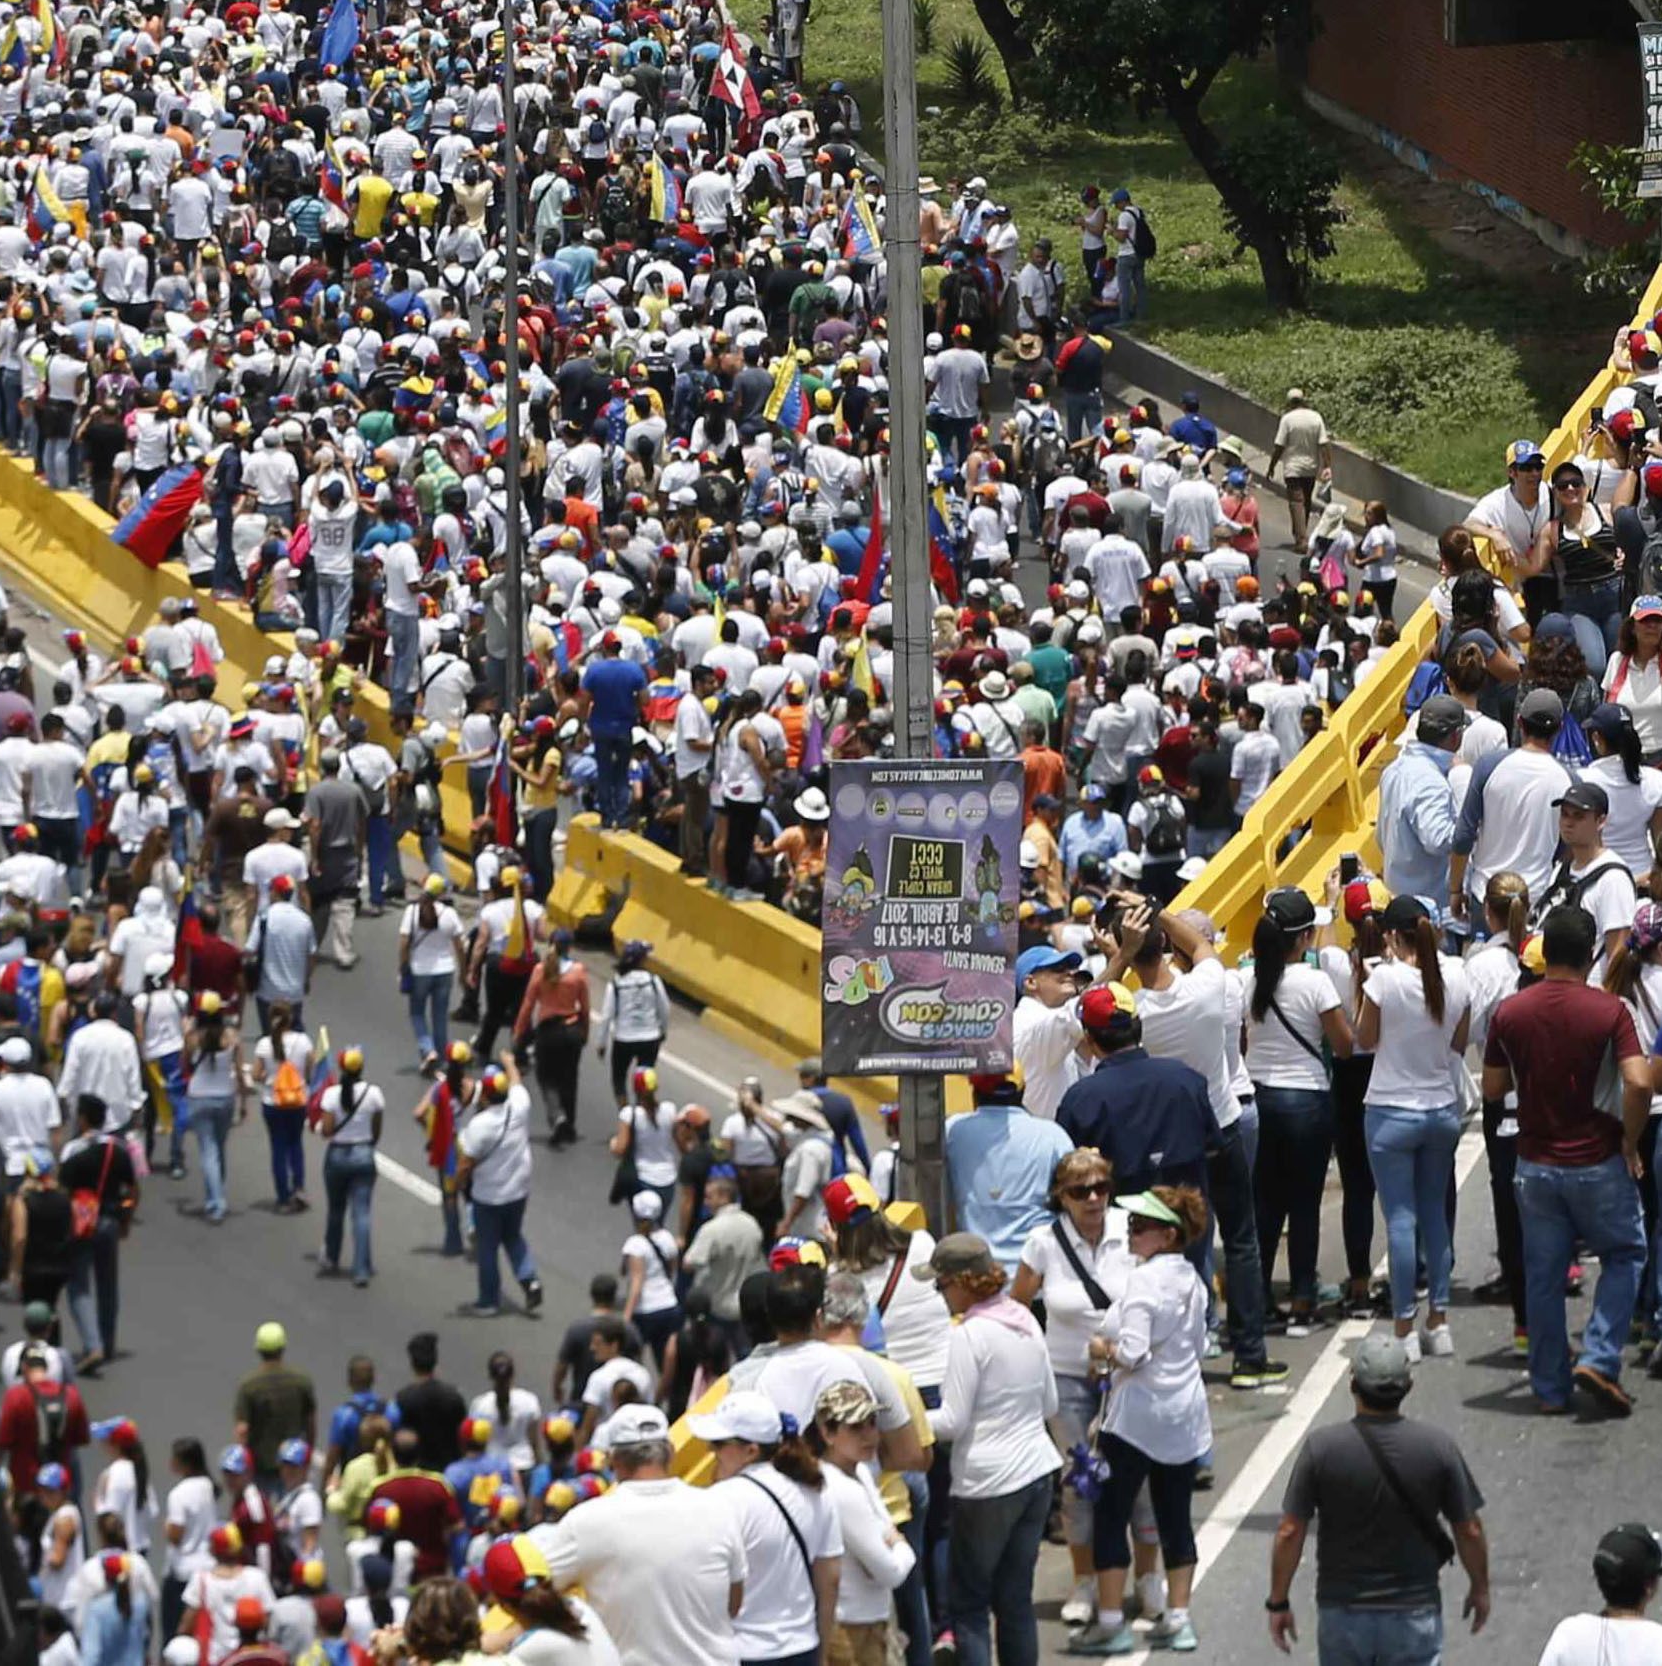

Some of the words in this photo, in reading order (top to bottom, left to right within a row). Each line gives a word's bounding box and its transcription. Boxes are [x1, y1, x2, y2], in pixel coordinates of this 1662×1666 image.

[909, 843, 943, 865] CCCT
[922, 865, 944, 879] NIVEL
[926, 880, 953, 895] URBAN
[880, 903, 908, 924] 2017
[910, 903, 944, 923] ABRIL
[945, 902, 959, 923] DE
[873, 925, 886, 946] 16
[889, 926, 897, 946] Y
[970, 953, 1007, 974] SEMANA
[922, 1023, 994, 1038] CARACAS
